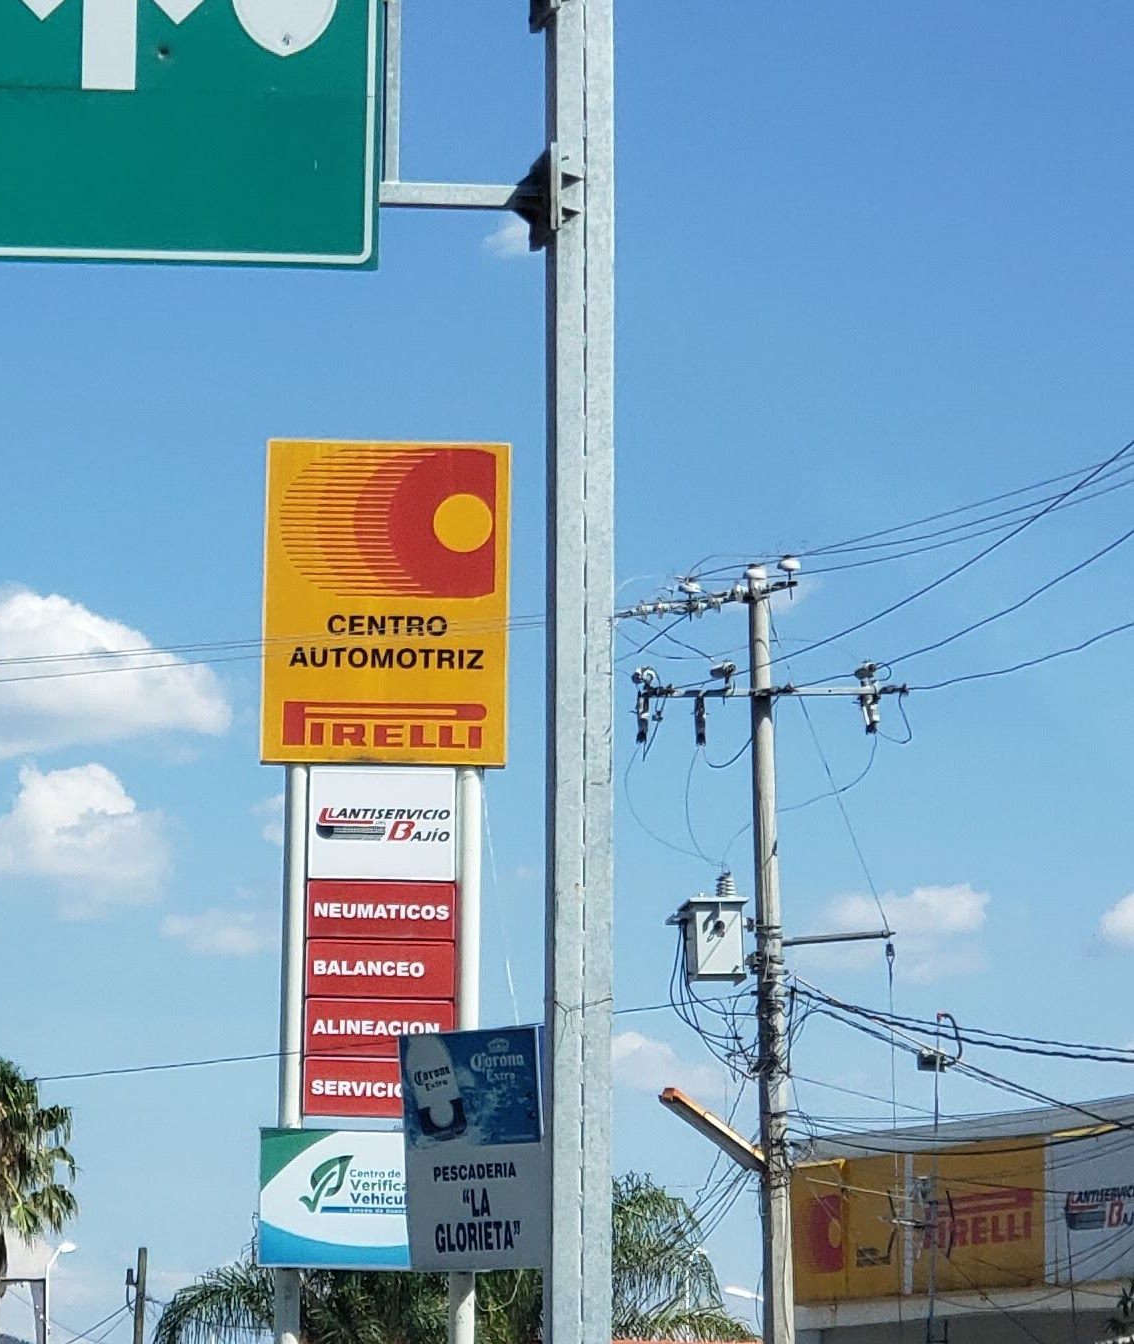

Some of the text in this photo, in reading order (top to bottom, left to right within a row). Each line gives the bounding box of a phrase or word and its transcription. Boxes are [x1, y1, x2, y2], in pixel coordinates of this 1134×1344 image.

[327, 614, 448, 637] CENTRO
[288, 646, 485, 670] AUTOMOTRIZ
[282, 701, 487, 749] PIRELLI
[318, 807, 451, 824] LLANTISERVICIO
[313, 902, 450, 921] NEUMATICOS
[313, 959, 425, 978] BALANCEO
[312, 1019, 440, 1036] ALINEACION
[470, 1052, 525, 1072] Corona
[414, 1066, 451, 1086] Corona
[486, 1069, 516, 1083] Extra
[349, 1169, 401, 1178] Centro de
[433, 1161, 517, 1183] PESCADERIA
[923, 1188, 1033, 1249] PIRELLI
